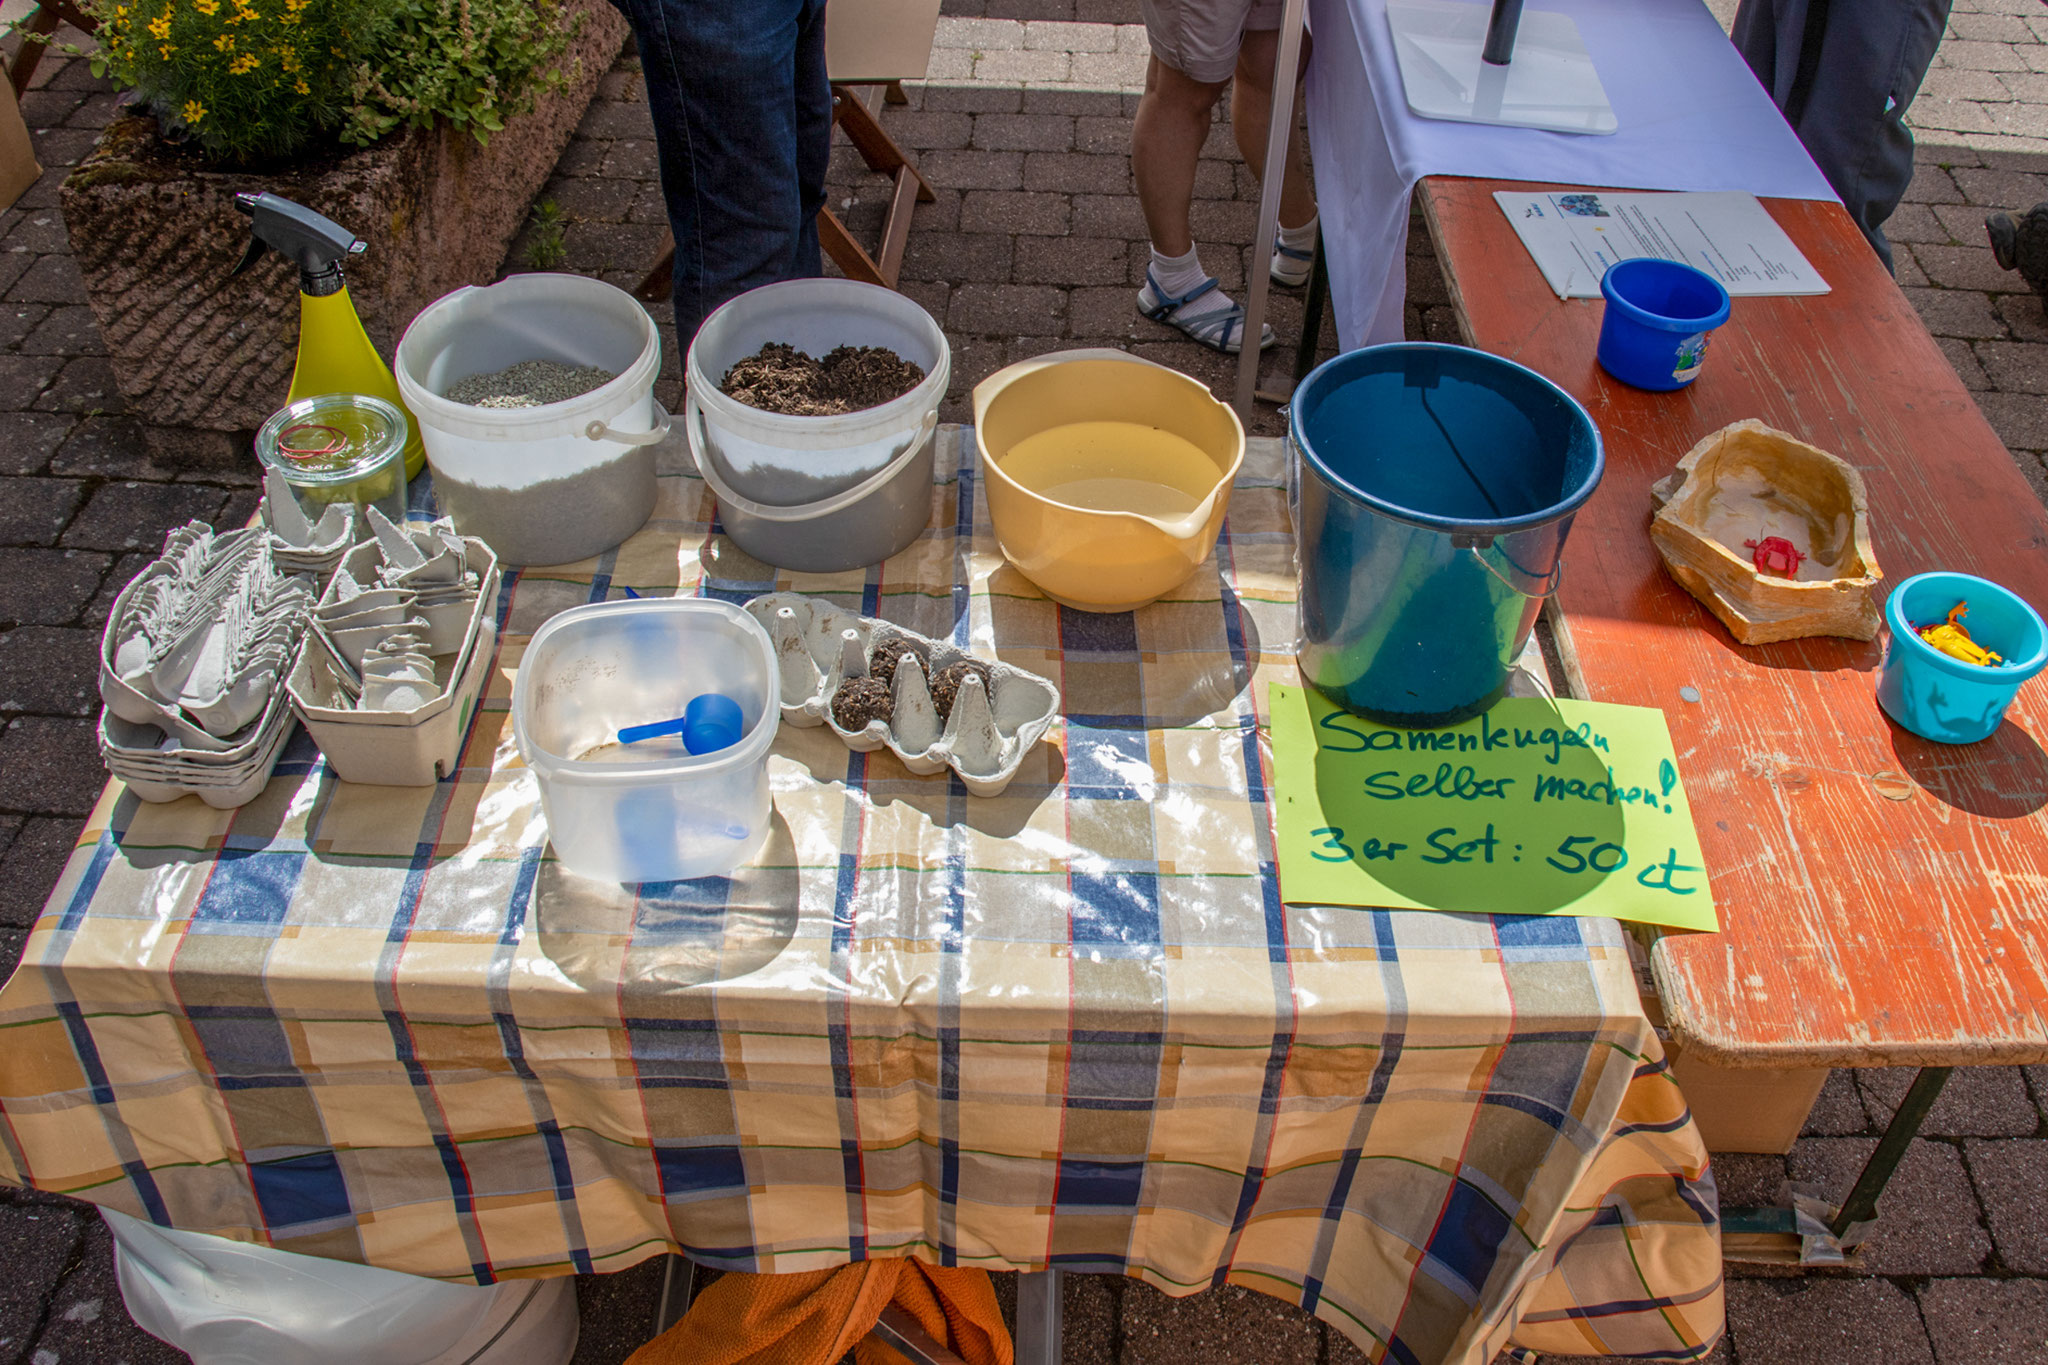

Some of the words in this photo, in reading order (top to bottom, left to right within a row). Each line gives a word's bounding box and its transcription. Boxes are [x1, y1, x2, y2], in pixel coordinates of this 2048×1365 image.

[1320, 711, 1609, 766] Samenkugeln
[1533, 757, 1677, 815] machen!
[1546, 835, 1629, 875] 50
[1637, 848, 1705, 896] ct
